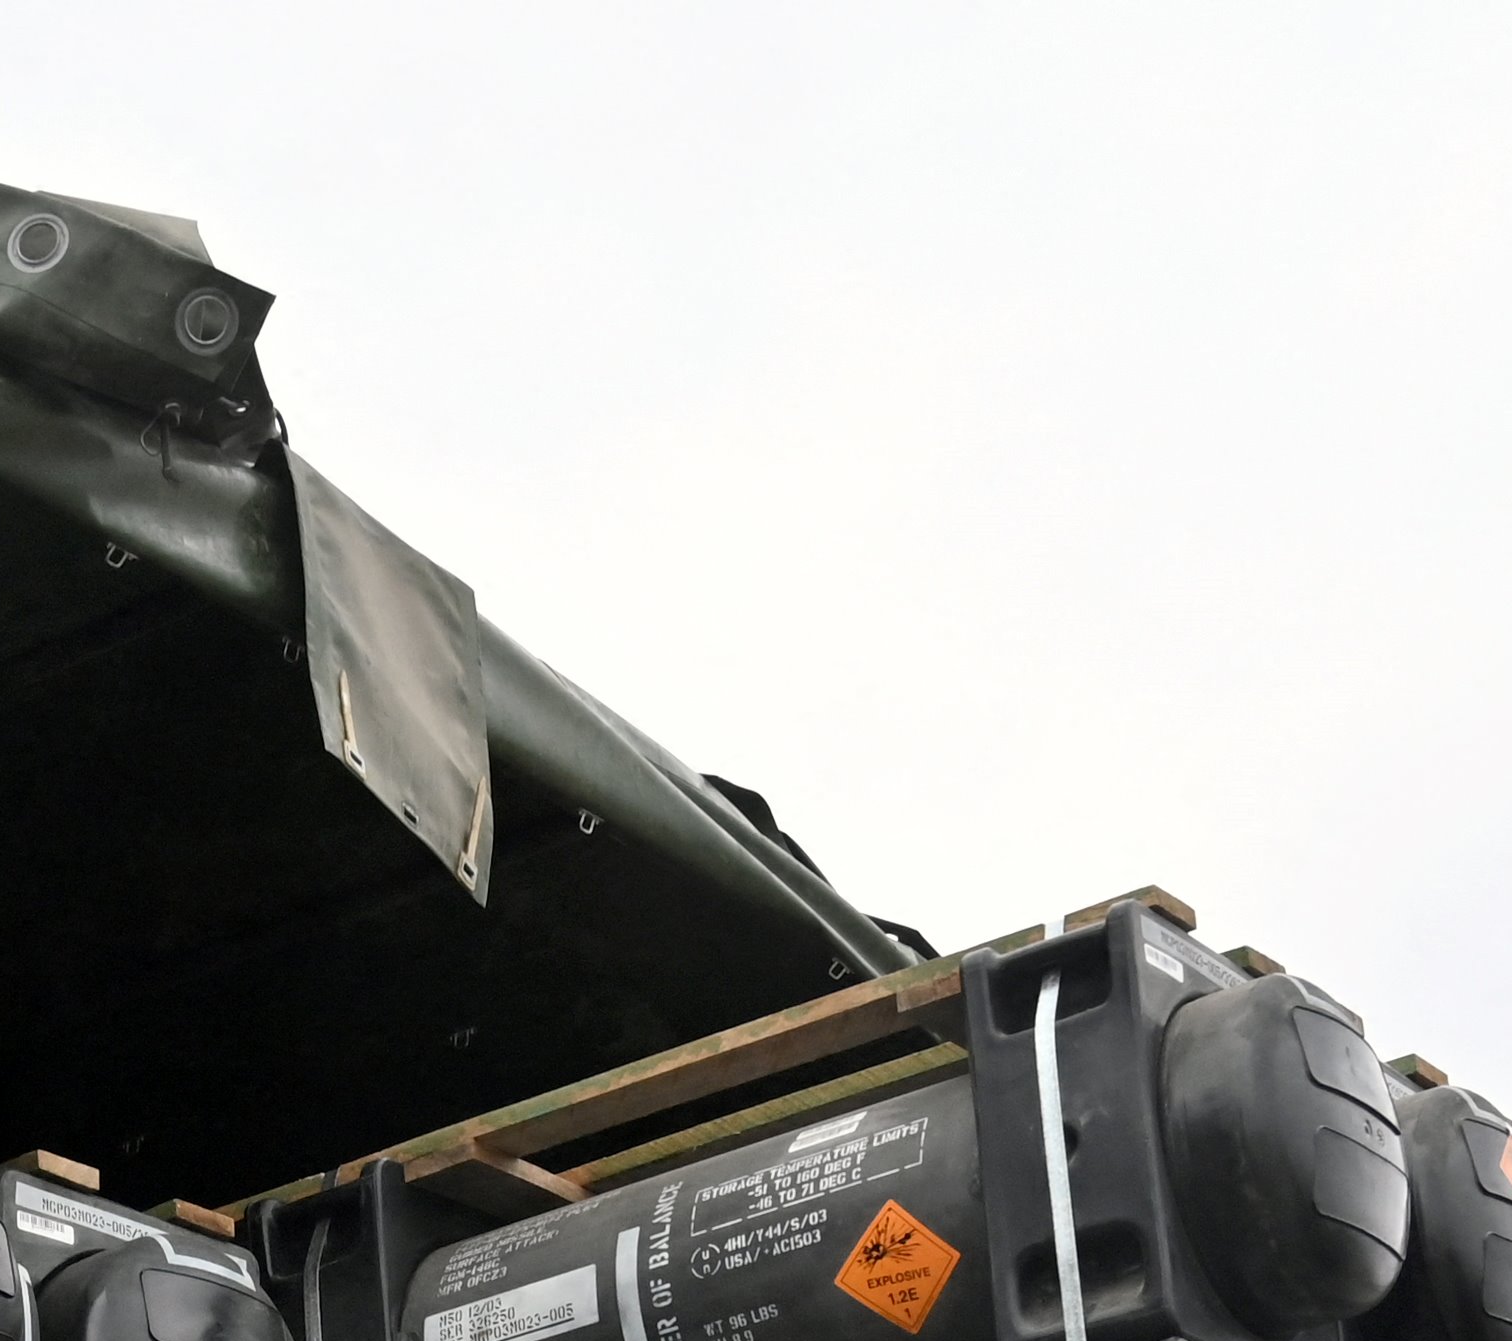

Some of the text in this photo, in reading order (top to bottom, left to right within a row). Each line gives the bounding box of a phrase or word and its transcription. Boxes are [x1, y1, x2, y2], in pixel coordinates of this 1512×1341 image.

[702, 1173, 763, 1202] STORAGE
[770, 1140, 867, 1180] TEMPERATURE
[873, 1123, 919, 1147] LIMITS
[747, 1152, 866, 1198] -51 TO 160 DEG F
[779, 1187, 796, 1203] TO
[802, 1182, 815, 1197] 71
[820, 1173, 846, 1192] DEG
[851, 1167, 861, 1181] C
[648, 1181, 683, 1270] BALANCE
[444, 1249, 500, 1273] SURFACE
[437, 1281, 463, 1298] MFR
[867, 1266, 931, 1289] EXPLOSIVE
[468, 1298, 502, 1318] 12/03
[649, 1280, 673, 1309] OF
[888, 1287, 919, 1305] 1.2E
[439, 1307, 515, 1341] SER 326250
[703, 1304, 779, 1337] WT 96 LBS
[904, 1308, 912, 1319] 1
